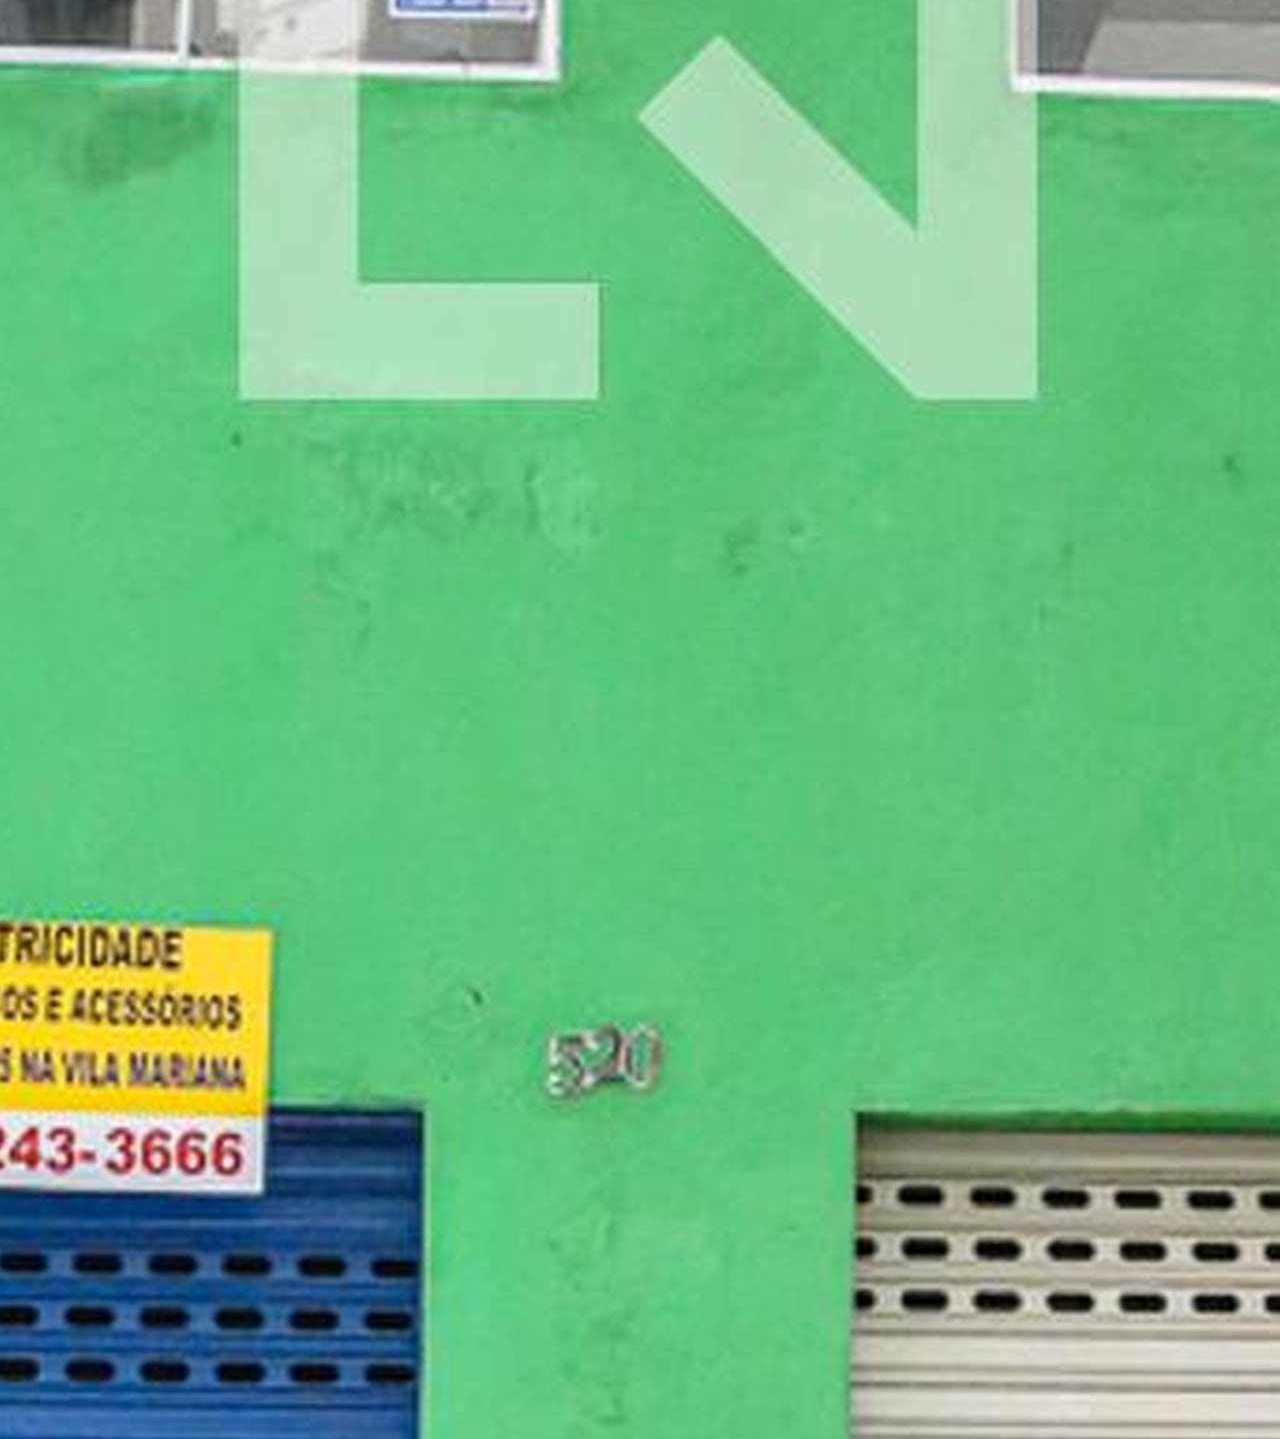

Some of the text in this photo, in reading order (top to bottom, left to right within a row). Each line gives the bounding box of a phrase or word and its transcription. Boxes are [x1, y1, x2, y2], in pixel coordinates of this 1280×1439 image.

[46, 987, 62, 1021] E
[21, 1050, 55, 1084] NA
[61, 1051, 120, 1088] VILA
[128, 1052, 247, 1092] MARIANA
